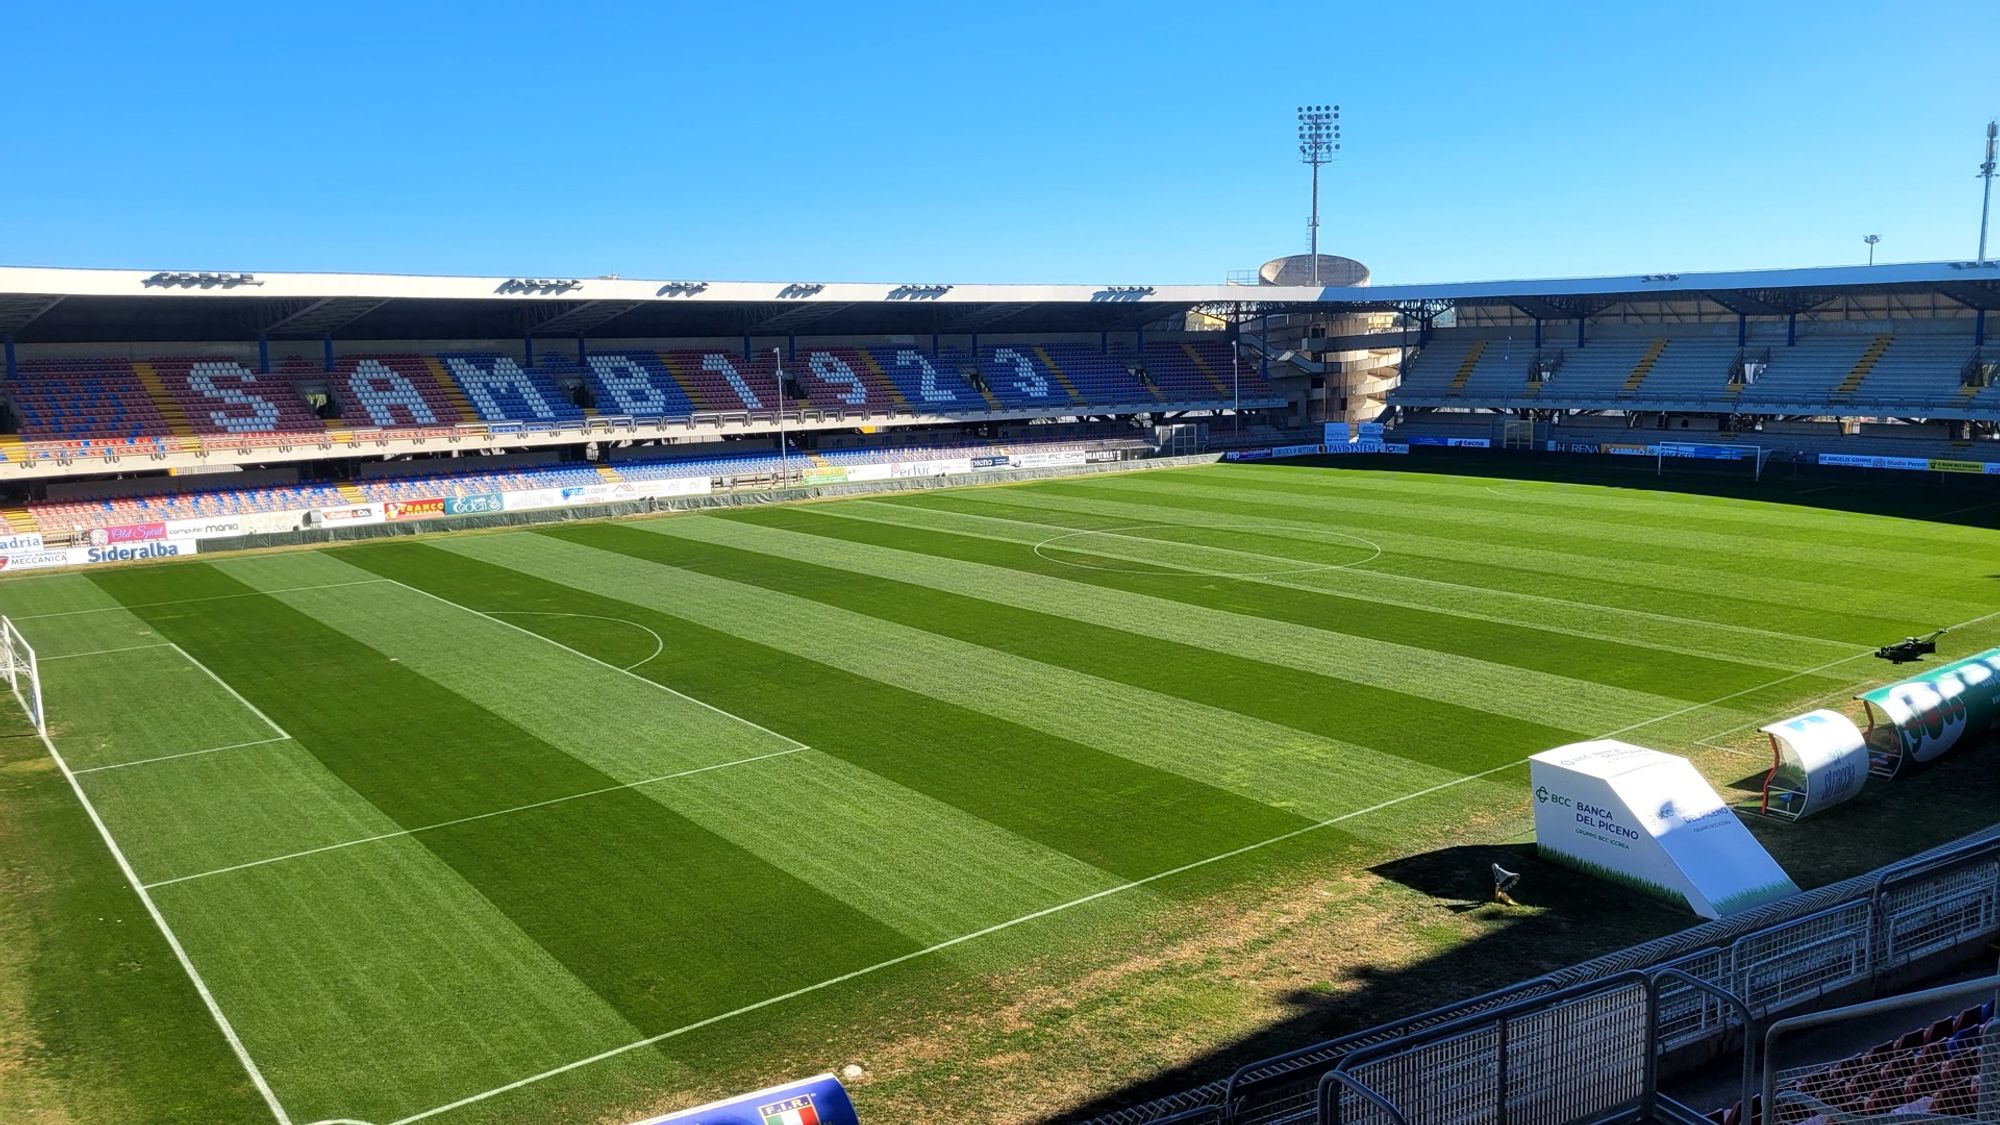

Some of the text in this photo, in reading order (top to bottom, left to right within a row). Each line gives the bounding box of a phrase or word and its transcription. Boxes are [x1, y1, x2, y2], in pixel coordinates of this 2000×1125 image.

[11, 555, 67, 566] MECCANICA
[87, 542, 178, 563] Sideralba
[1551, 794, 1613, 821] BCC BANCA
[1576, 813, 1639, 840] DEL PICENO
[766, 1098, 808, 1114] F.I.R.
